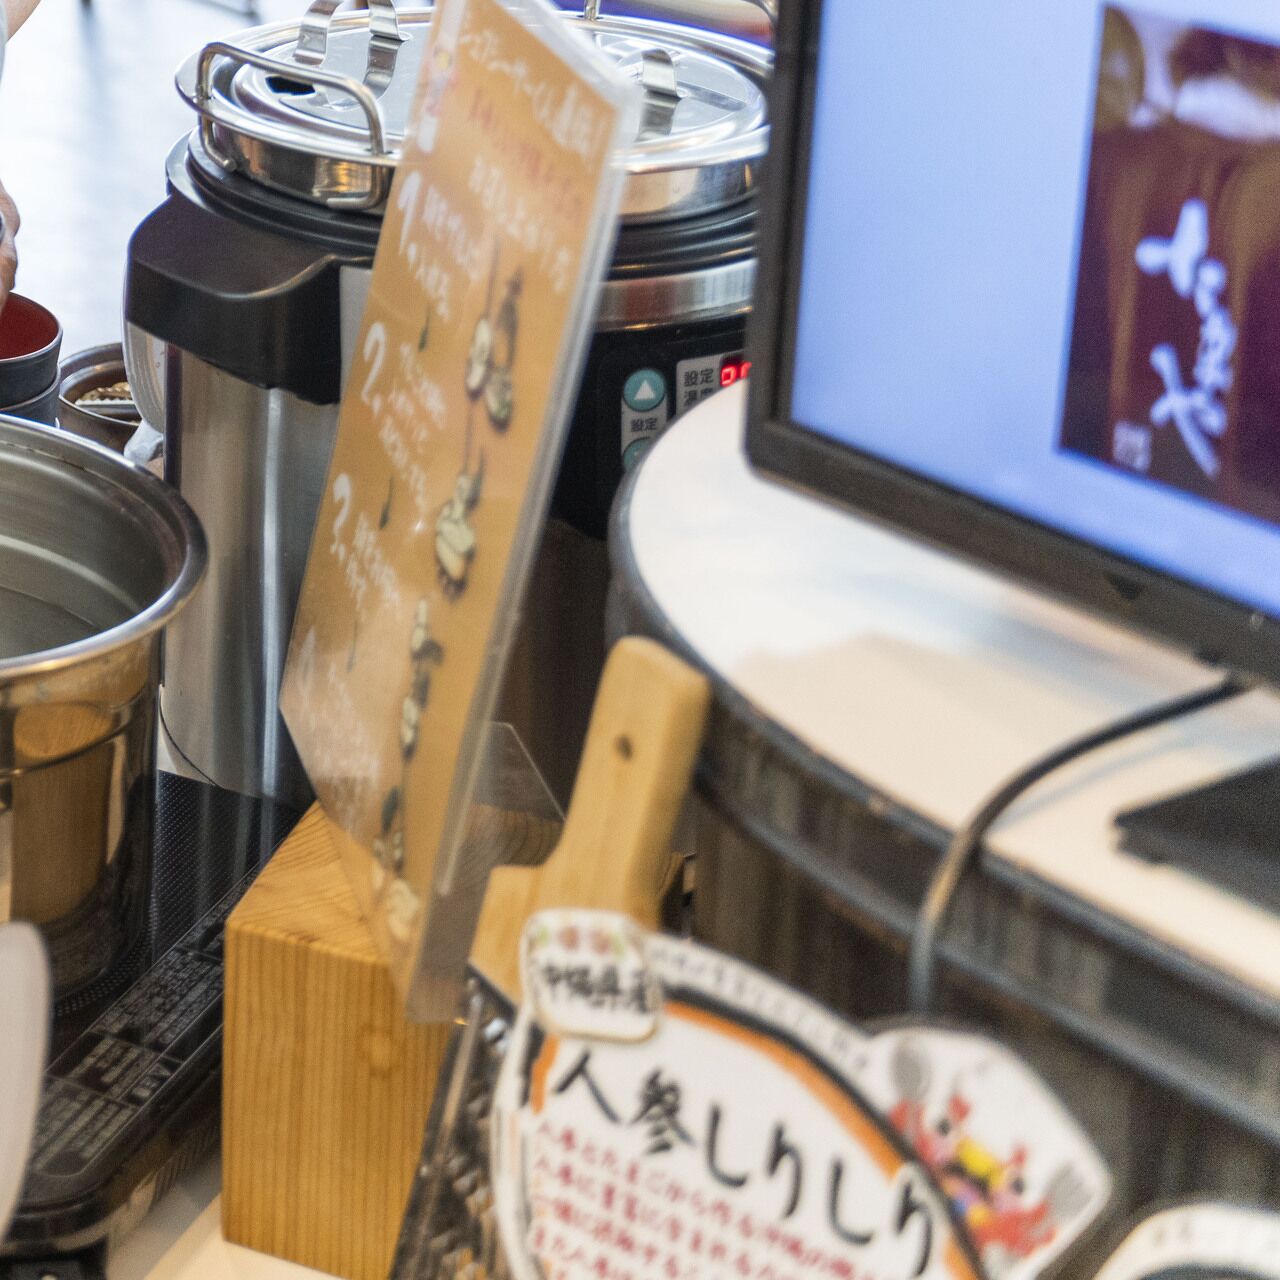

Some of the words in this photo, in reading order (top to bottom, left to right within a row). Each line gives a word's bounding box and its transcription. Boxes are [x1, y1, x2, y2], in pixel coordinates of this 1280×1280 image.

[683, 368, 714, 387] 設定
[629, 418, 658, 432] 設定
[552, 1050, 934, 1279] 人参しりしり
